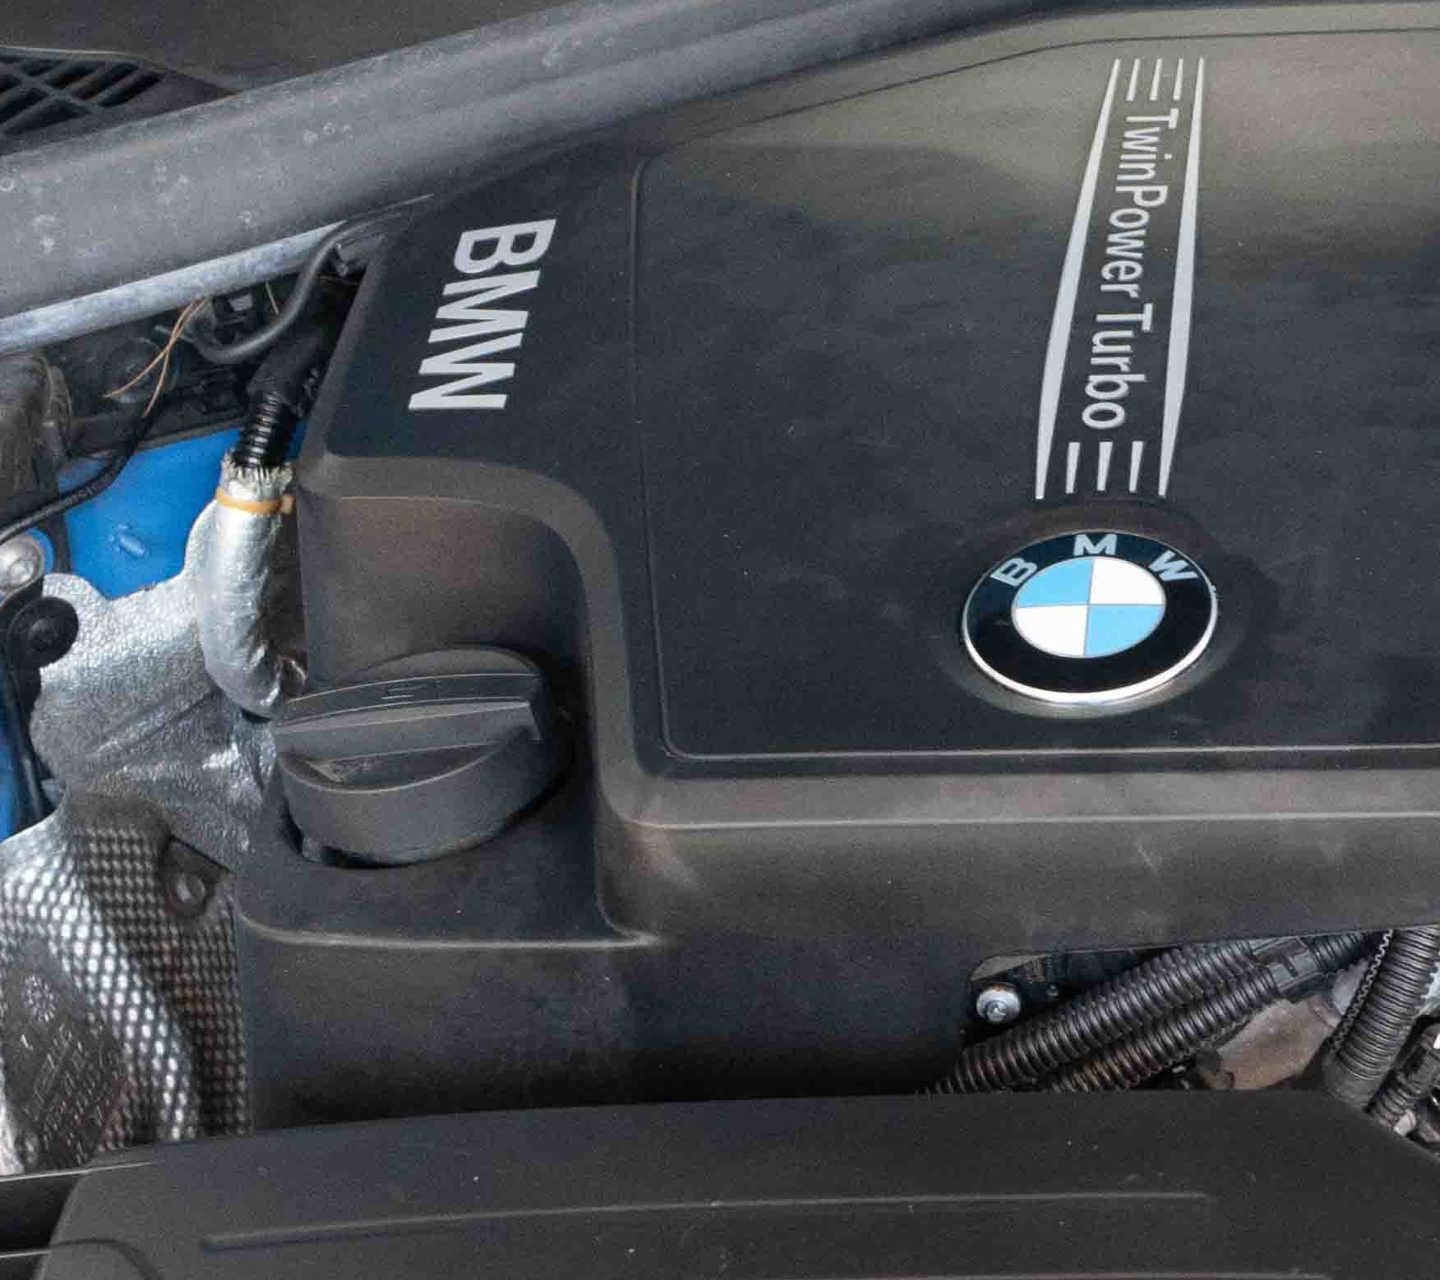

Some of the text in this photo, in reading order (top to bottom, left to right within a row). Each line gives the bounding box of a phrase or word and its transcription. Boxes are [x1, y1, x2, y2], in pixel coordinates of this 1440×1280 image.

[408, 218, 557, 411] BMW
[1083, 109, 1180, 430] TwinPower Turbo
[992, 532, 1200, 584] BMW
